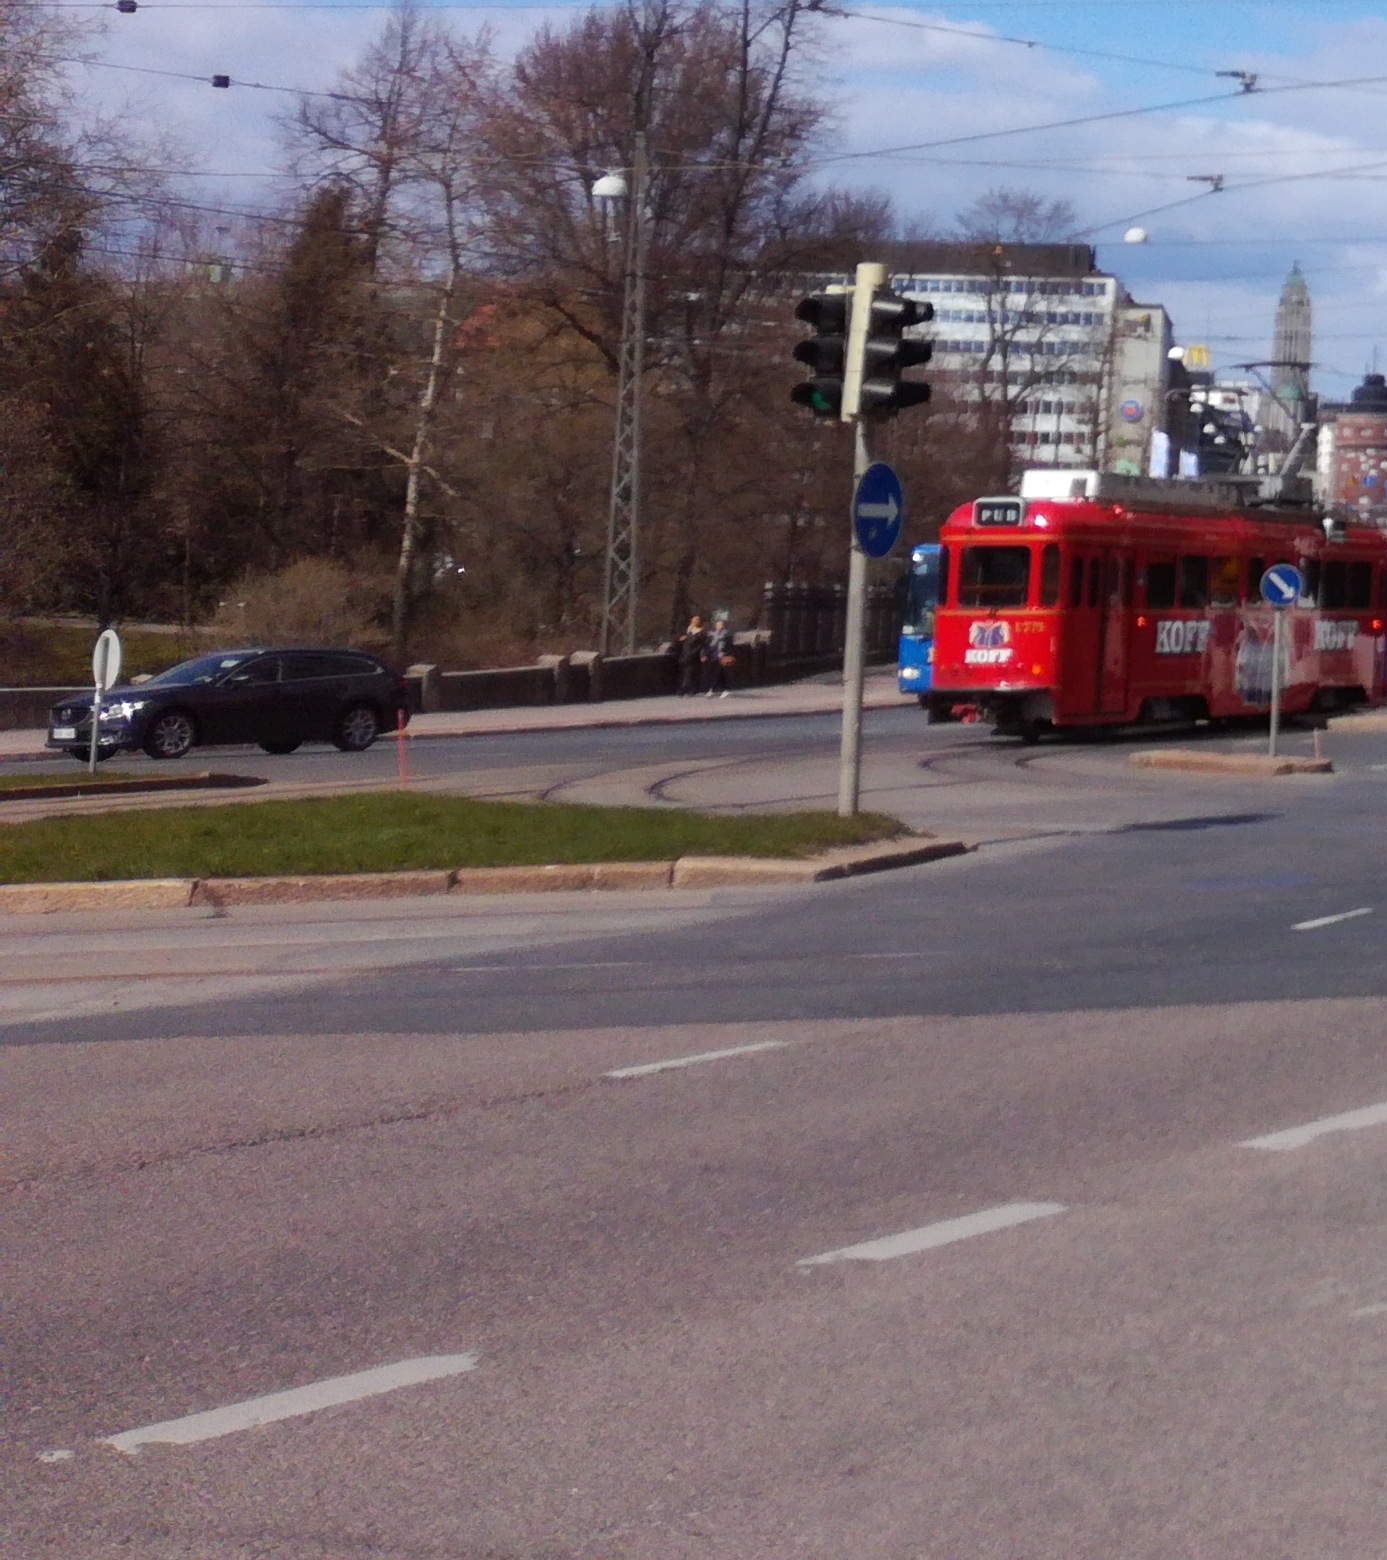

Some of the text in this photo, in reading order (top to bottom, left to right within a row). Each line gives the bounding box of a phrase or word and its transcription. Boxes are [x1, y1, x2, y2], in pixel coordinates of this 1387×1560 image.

[980, 508, 1018, 523] PUB
[1154, 619, 1212, 654] KOFF
[964, 648, 1014, 664] KOFF
